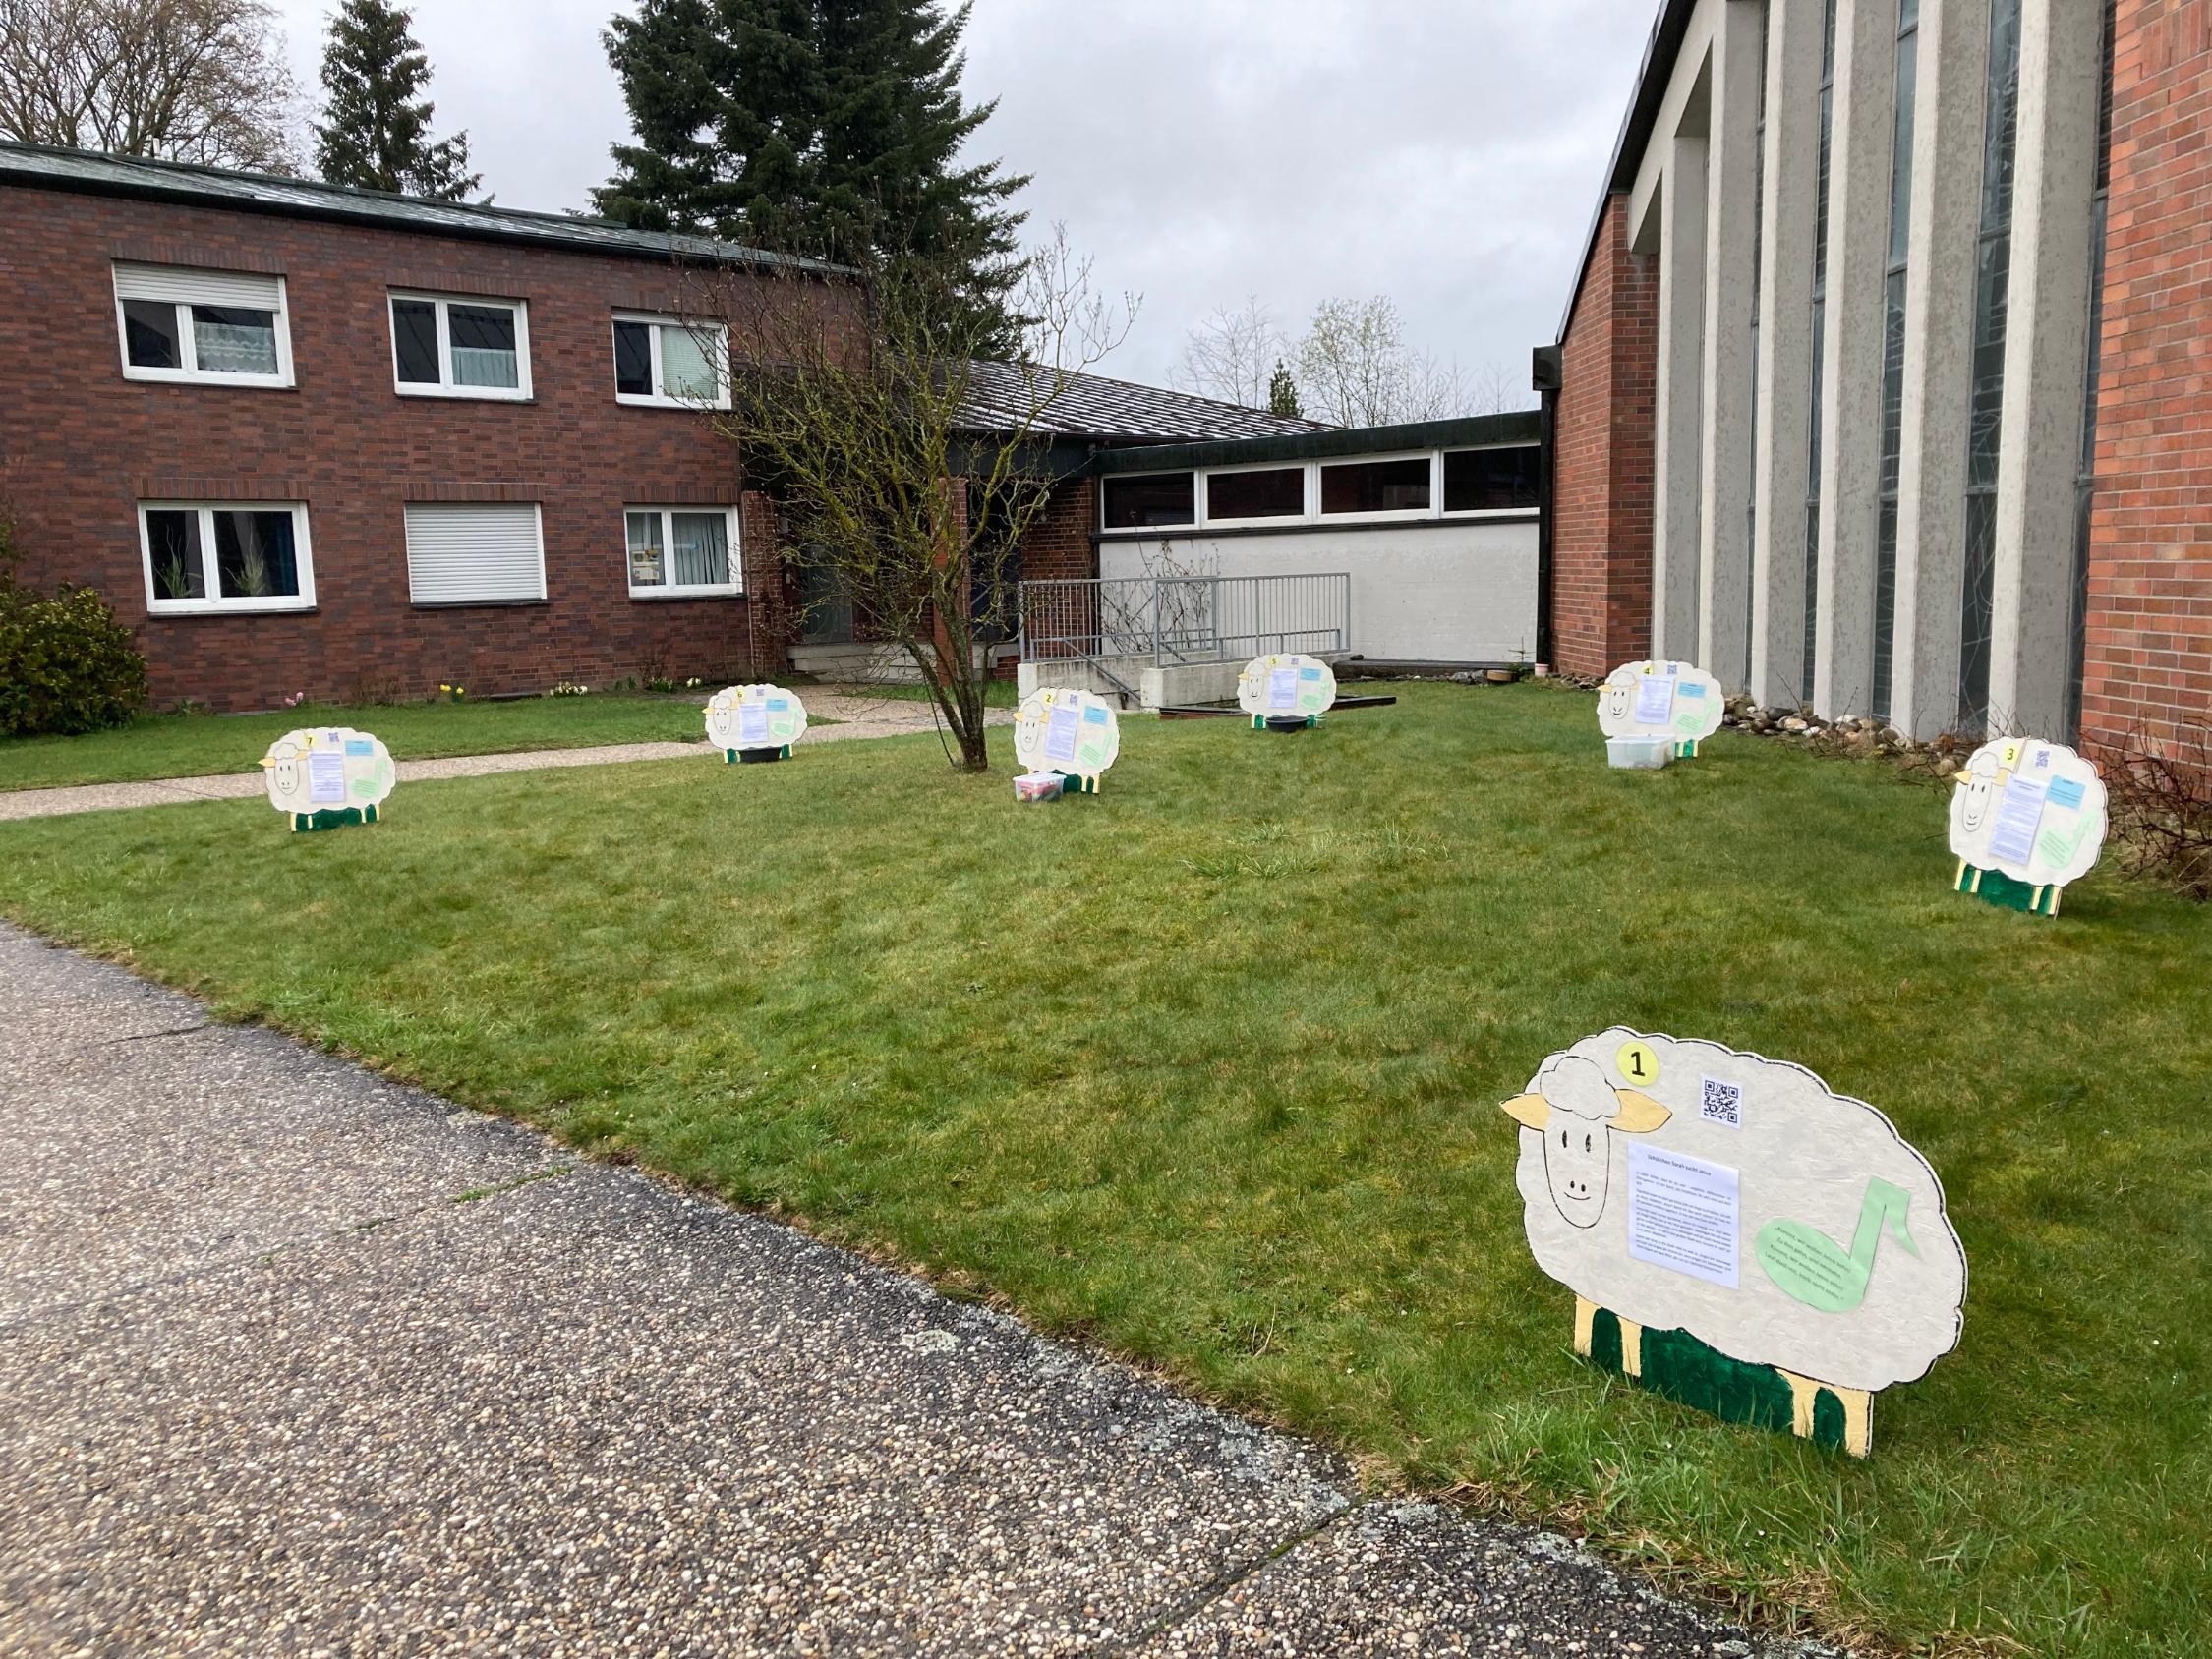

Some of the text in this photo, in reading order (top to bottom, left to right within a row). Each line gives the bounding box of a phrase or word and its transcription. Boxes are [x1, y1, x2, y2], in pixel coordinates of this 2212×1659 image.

[1046, 694, 1051, 703] 2
[2007, 748, 2014, 761] 3
[1629, 1051, 1647, 1077] 1
